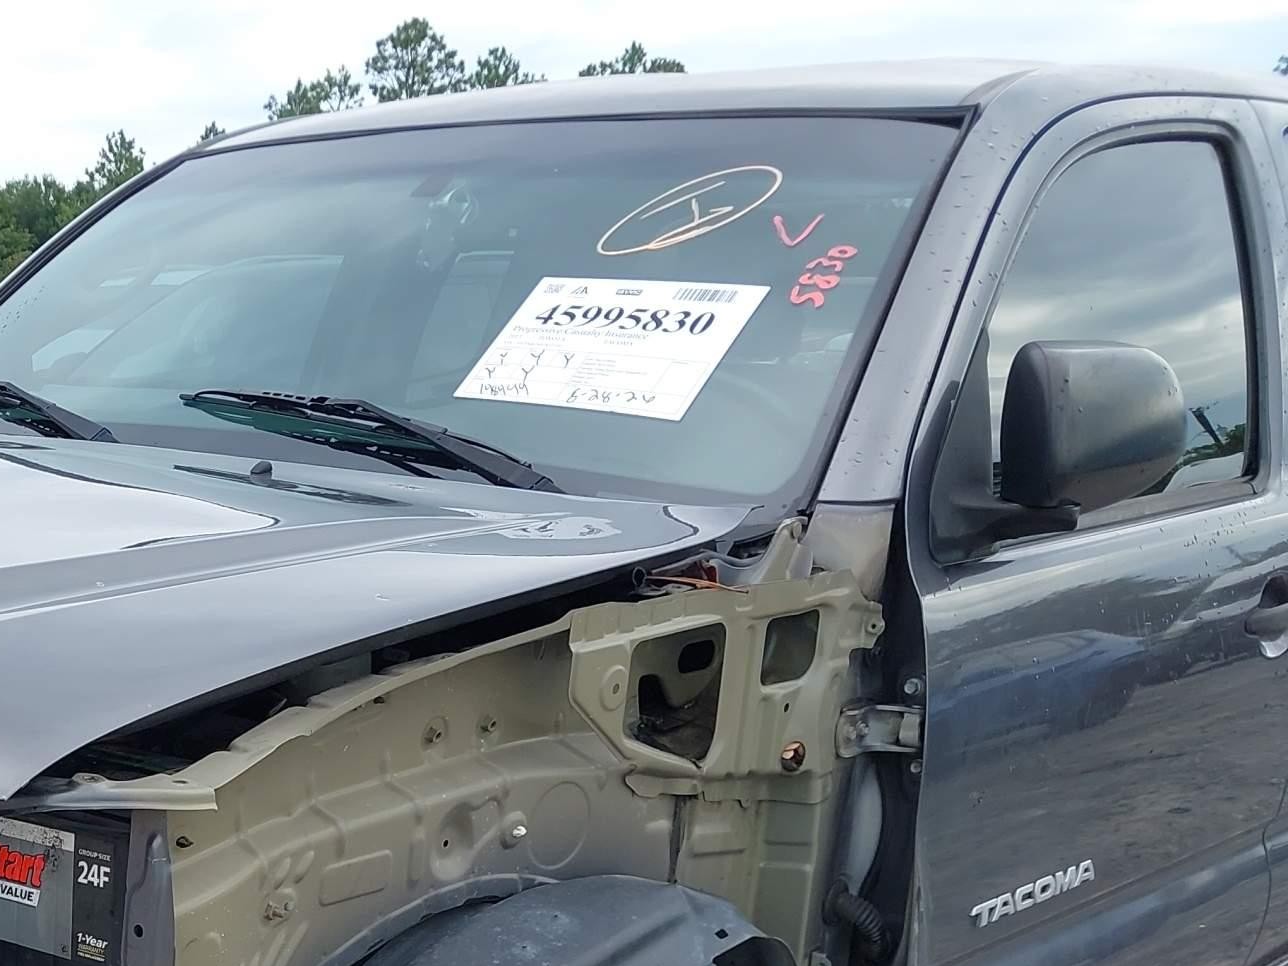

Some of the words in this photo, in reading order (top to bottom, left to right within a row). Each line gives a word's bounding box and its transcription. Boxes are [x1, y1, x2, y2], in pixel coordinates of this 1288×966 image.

[790, 245, 858, 308] 5830
[535, 304, 716, 335] 45995830
[77, 861, 111, 888] 24F
[0, 884, 34, 901] VALUE
[969, 858, 1096, 928] TACOMA
[76, 932, 109, 949] 1-Year
